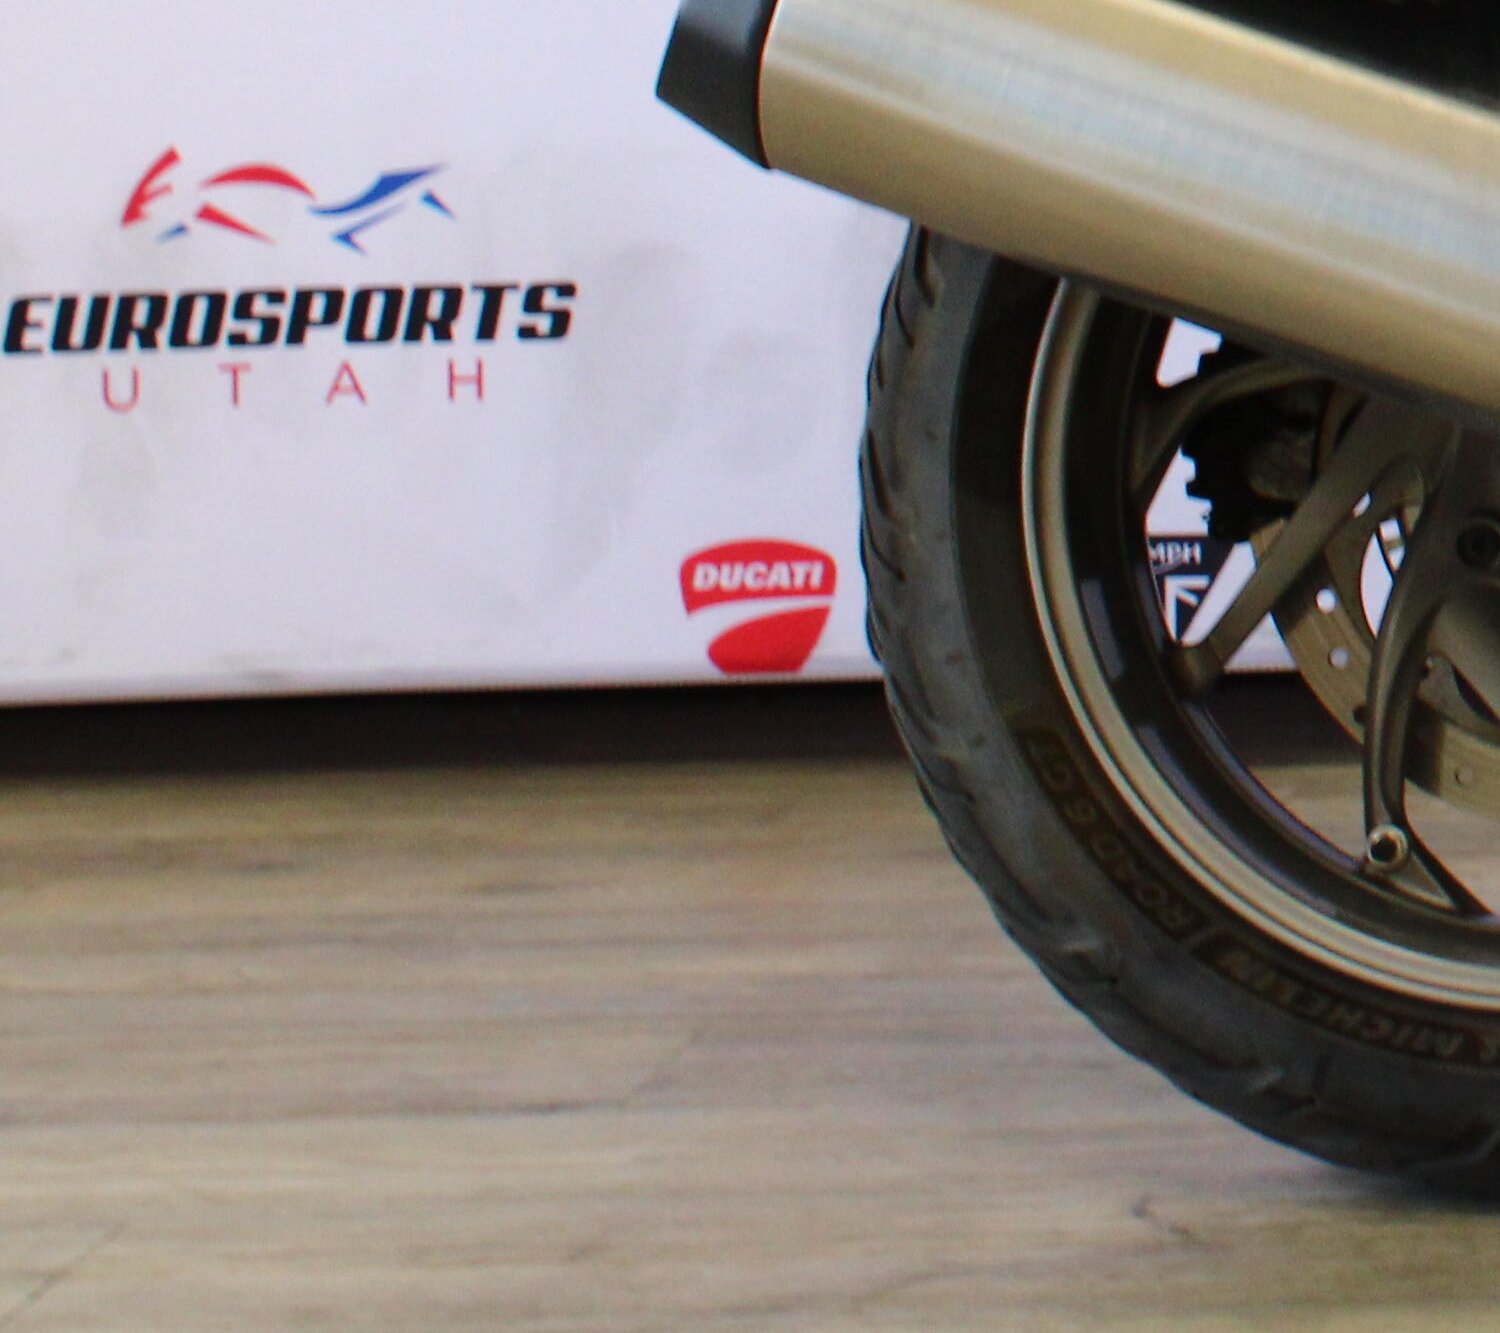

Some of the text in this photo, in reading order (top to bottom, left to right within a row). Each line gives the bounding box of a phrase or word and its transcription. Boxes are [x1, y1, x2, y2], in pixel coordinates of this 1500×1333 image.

[2, 281, 578, 356] EUROSPORTS
[102, 358, 486, 414] UTAH
[692, 560, 824, 592] DUCATI
[1210, 931, 1468, 1060] MICHELIN
